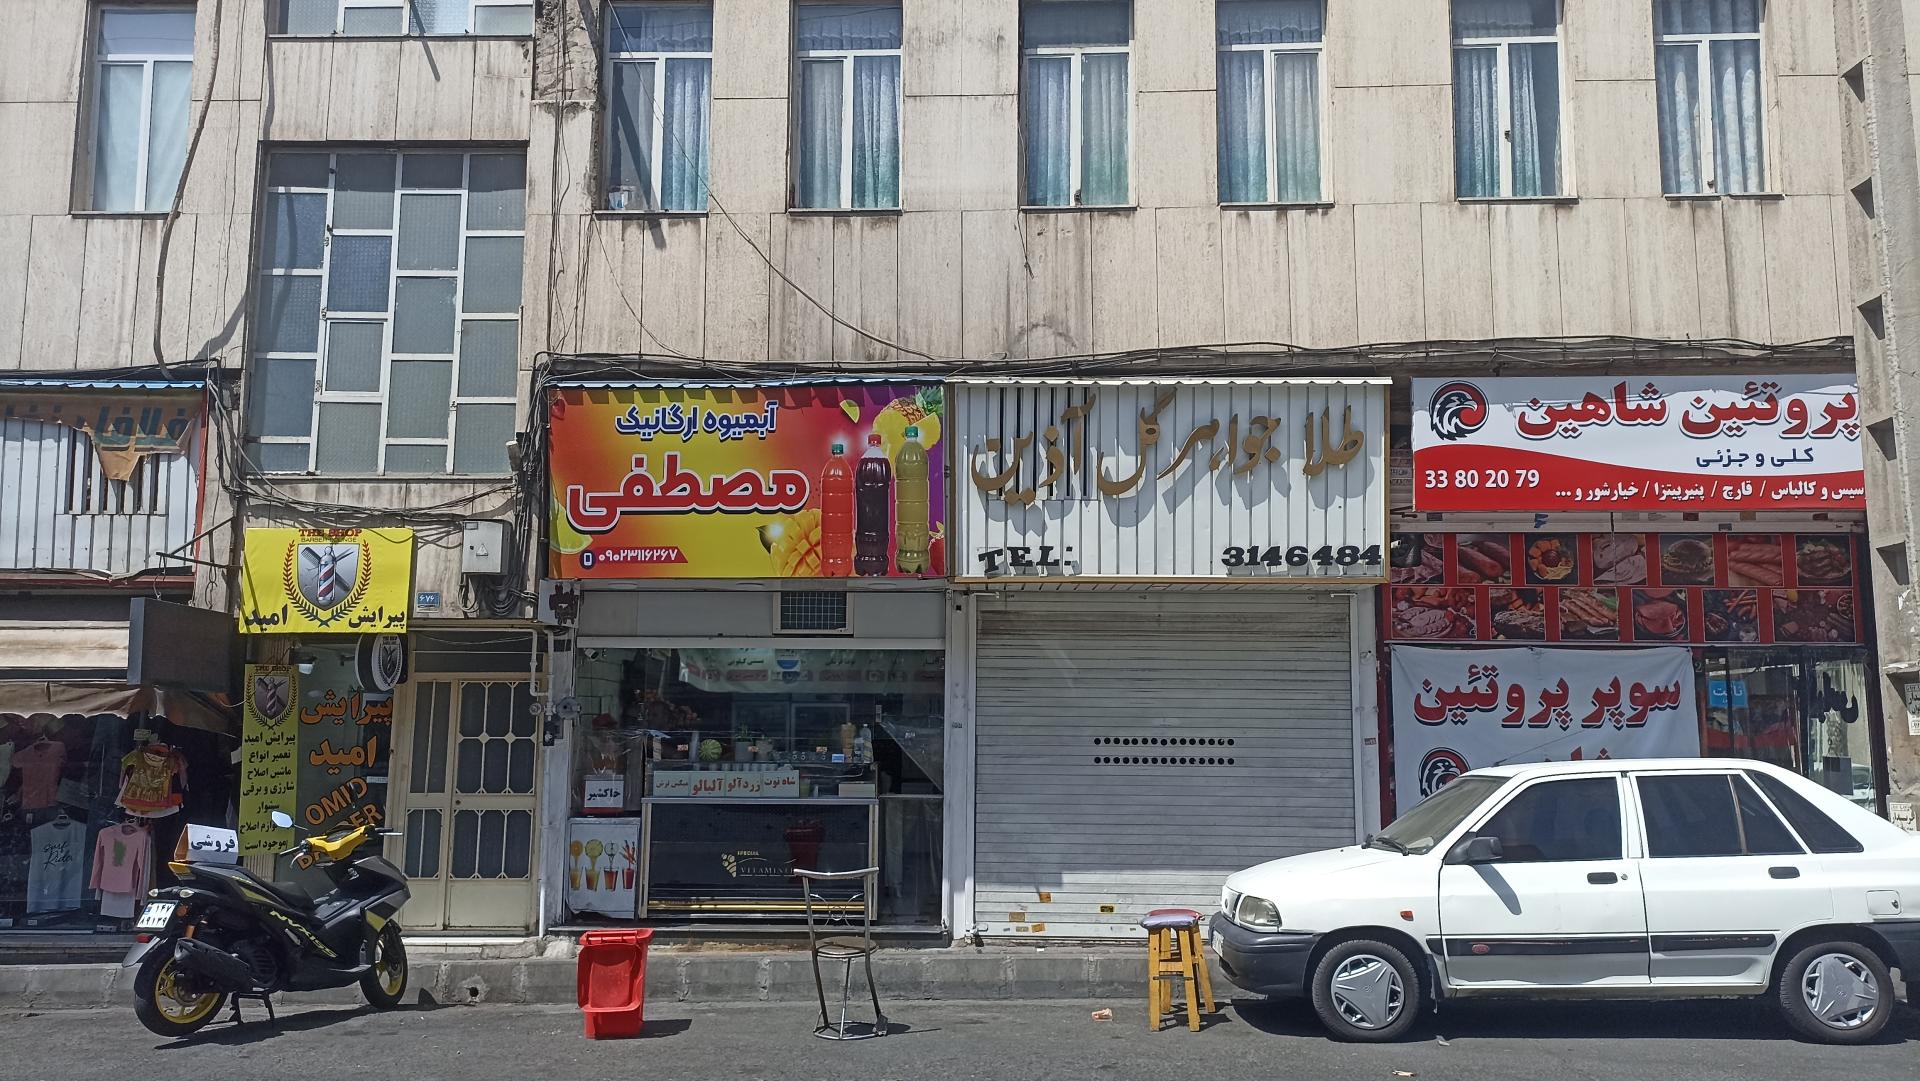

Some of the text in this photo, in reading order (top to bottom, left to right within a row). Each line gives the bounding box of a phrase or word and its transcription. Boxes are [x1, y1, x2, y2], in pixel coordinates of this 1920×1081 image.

[1515, 380, 1860, 441] پروتئین شاهین
[615, 401, 778, 442] آبمیوه ارگانیک
[1157, 414, 1282, 480] جواهر
[1303, 404, 1365, 476] طلا
[1696, 447, 1814, 468] کلی و جزئی
[1425, 469, 1448, 488] 33
[1455, 469, 1479, 488] 80
[1485, 469, 1509, 488] 20
[1515, 469, 1540, 488] 79
[566, 452, 811, 534] مصطفی
[1574, 487, 1582, 501] و
[1722, 480, 1753, 499] قارچ
[1771, 480, 1816, 500] کالباس
[1821, 486, 1828, 500] و
[1831, 484, 1866, 500] سیس
[978, 544, 1382, 573] TEL: 3146484
[245, 603, 405, 632] پیرایش امید
[301, 689, 393, 726] پیرایش
[1414, 664, 1681, 731] سوپر پروتئین
[244, 731, 296, 746] پیرایش امید
[249, 749, 291, 763] تعمیر انواع
[310, 735, 377, 775] امید
[247, 765, 292, 780] ماشین اصلاح
[304, 776, 369, 826] OMID
[586, 788, 621, 801] خاکشیر
[260, 820, 278, 833] وازم
[190, 834, 236, 853] فروشی
[245, 839, 262, 851] است
